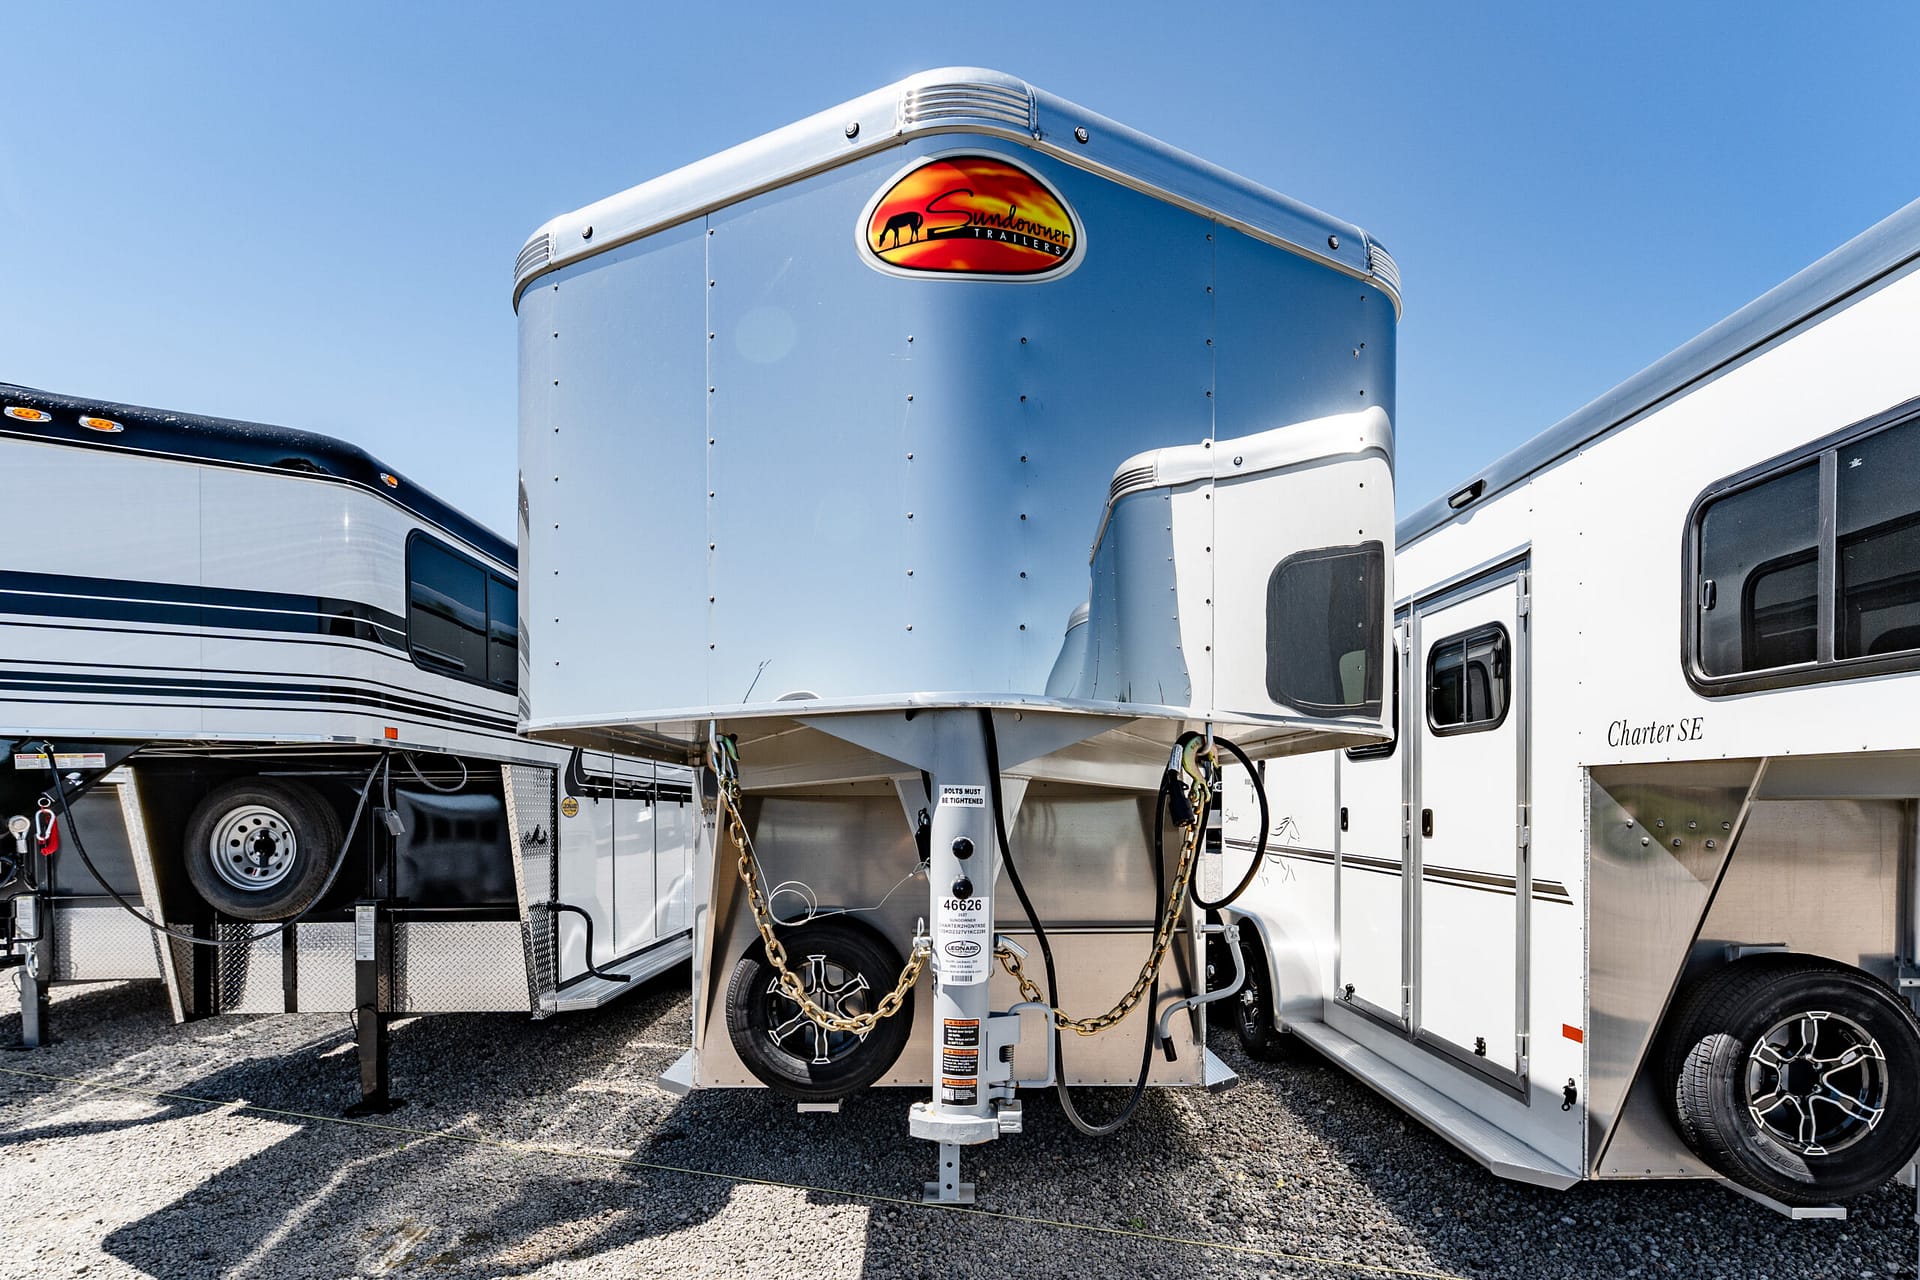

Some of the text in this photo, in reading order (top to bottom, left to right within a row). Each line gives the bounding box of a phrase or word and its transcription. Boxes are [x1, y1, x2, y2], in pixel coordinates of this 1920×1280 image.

[925, 188, 1071, 244] Sundowner
[974, 228, 1061, 255] TRAILERS
[1607, 717, 1704, 747] Charter SE
[944, 787, 963, 795] BOLTS
[943, 899, 982, 911] 46626
